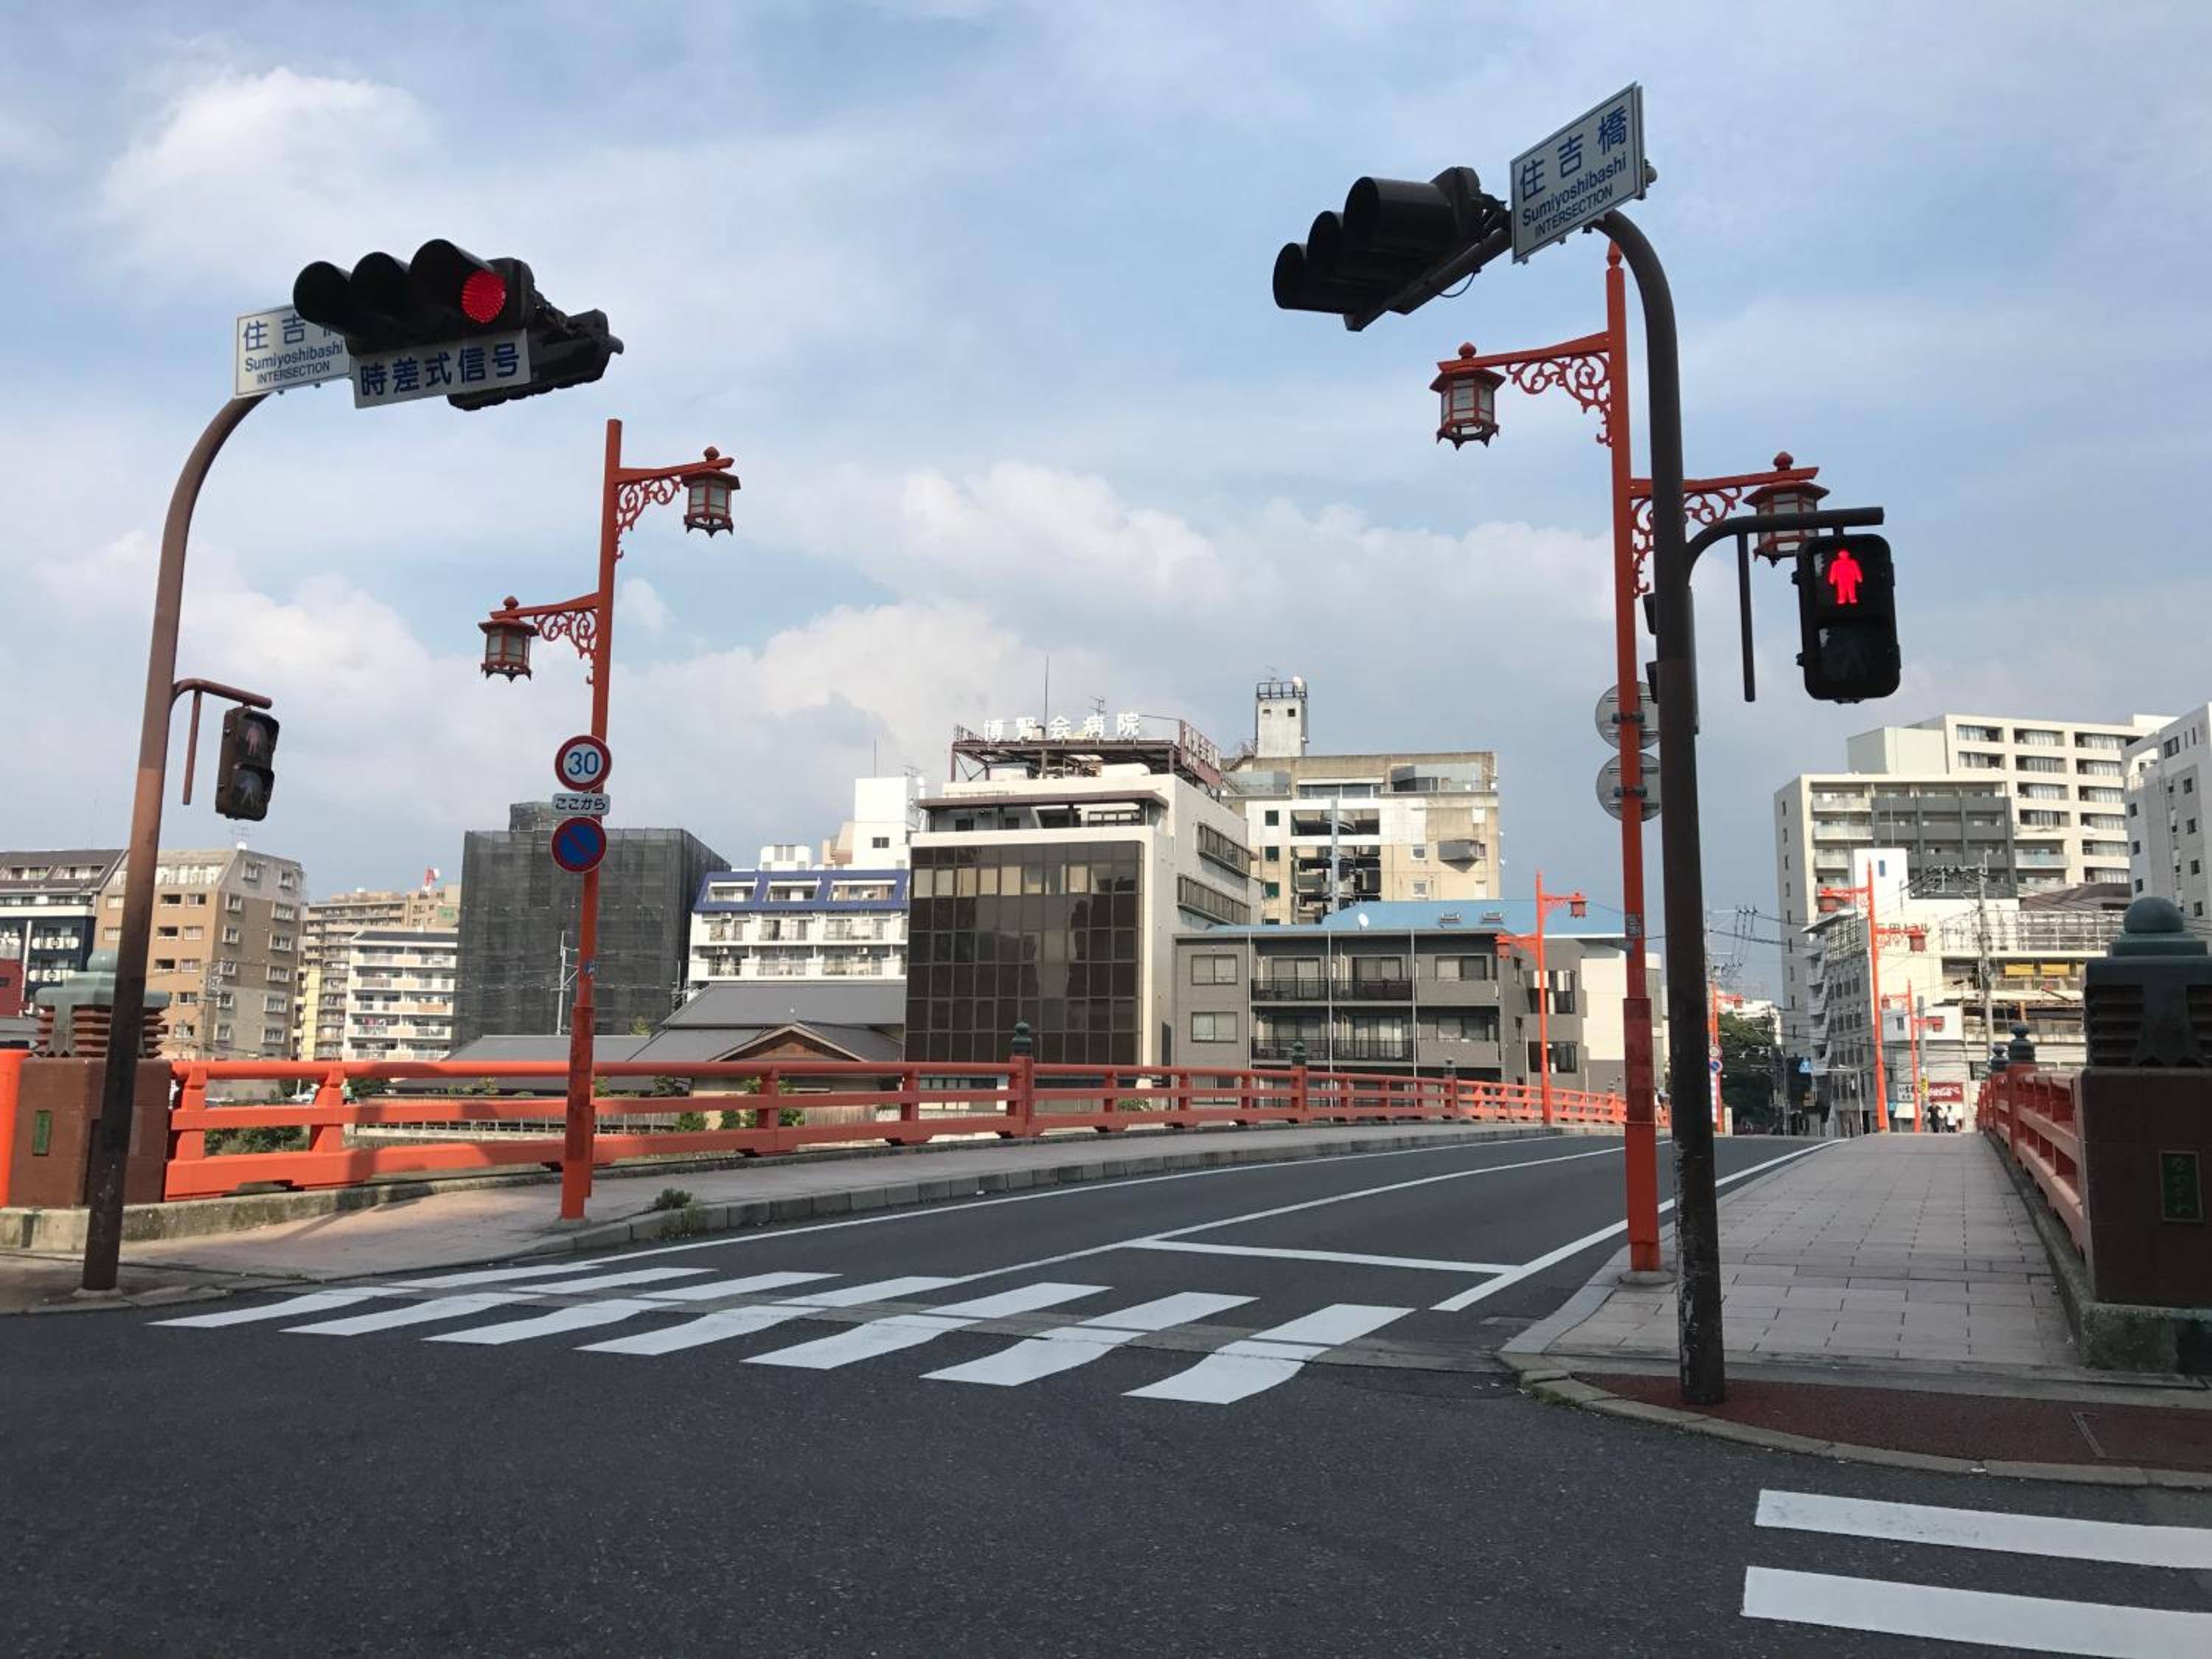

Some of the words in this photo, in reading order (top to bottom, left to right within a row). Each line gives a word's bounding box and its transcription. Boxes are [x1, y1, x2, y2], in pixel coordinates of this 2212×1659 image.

[1520, 105, 1627, 202] 住吉橋
[1523, 152, 1627, 228] Sumiyoshibashi
[1535, 184, 1614, 238] INTERSECTION
[243, 313, 331, 352] 住吉
[245, 341, 344, 372] Sumiyoshibashi
[258, 361, 330, 383] INTERSECTION
[360, 342, 521, 397] 時差式信号
[568, 751, 599, 775] 30
[555, 798, 605, 810] ここから
